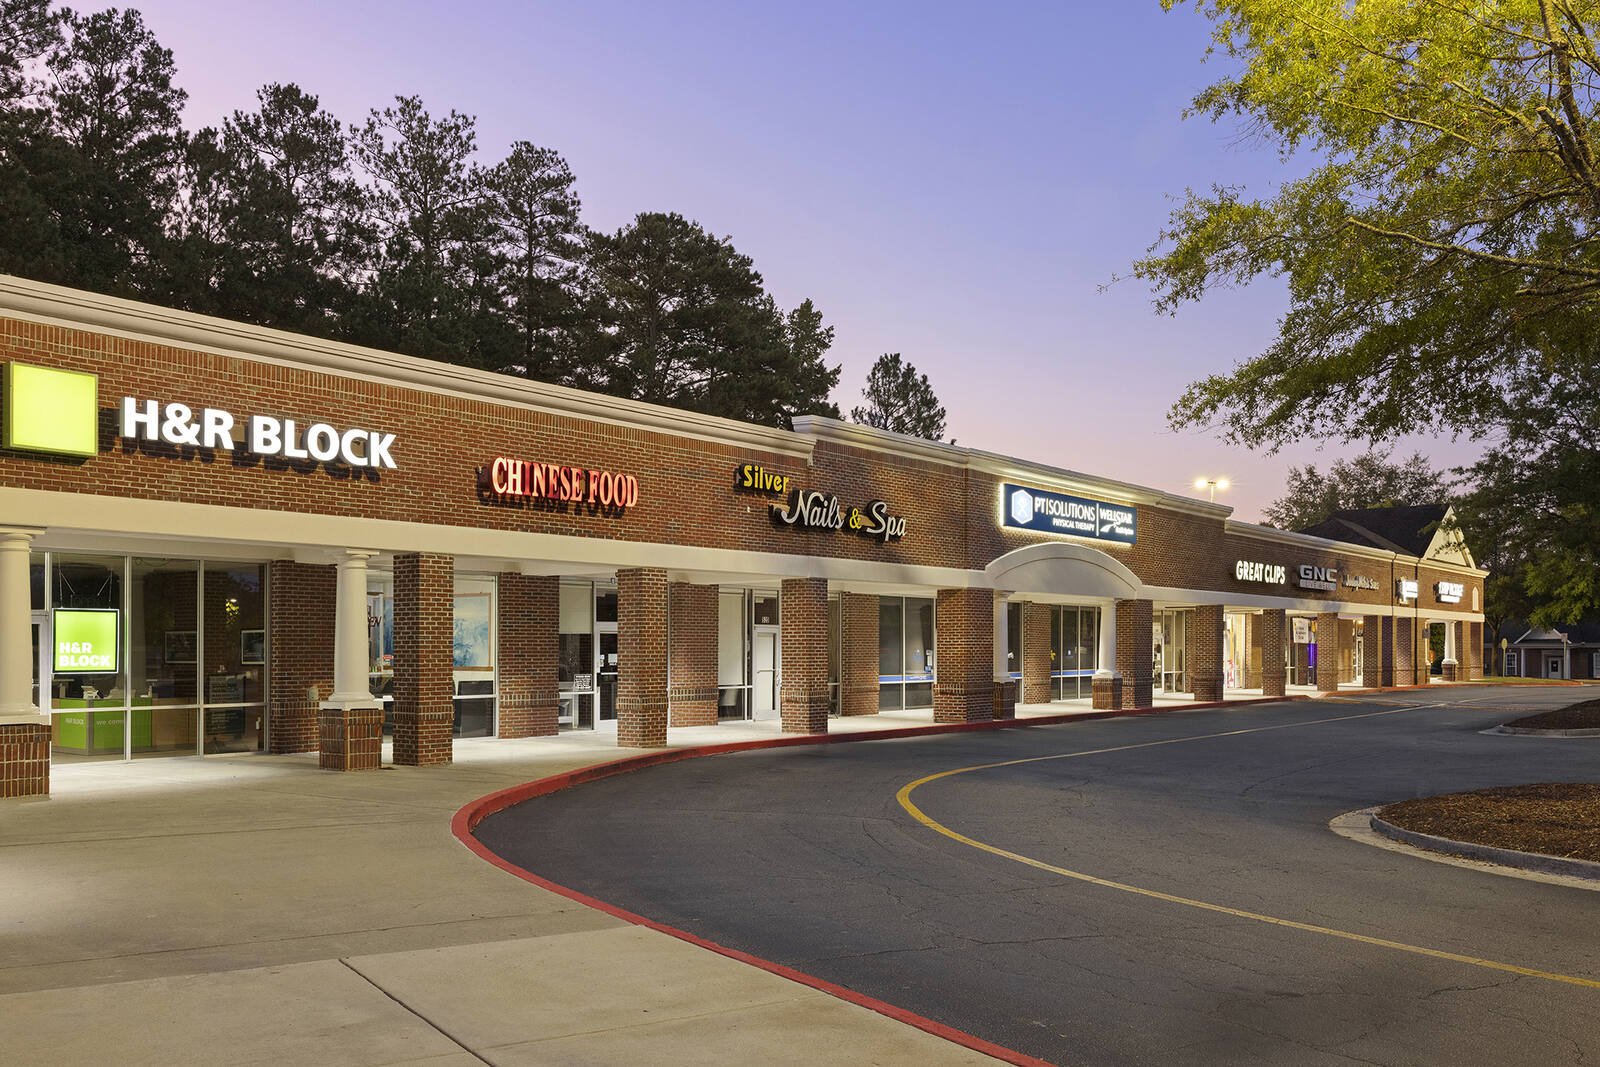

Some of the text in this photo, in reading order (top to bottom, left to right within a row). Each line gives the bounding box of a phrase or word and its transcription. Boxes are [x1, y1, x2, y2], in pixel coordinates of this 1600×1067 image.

[121, 396, 398, 470] H&R BLOCK
[490, 456, 639, 508] CHINESE FOOD
[743, 464, 790, 493] Silver
[781, 490, 907, 542] Nails & Spa
[1034, 496, 1095, 521] PT SOLUTIONS
[1052, 517, 1095, 532] PHYSICAL THERAPY
[1236, 560, 1286, 585] GREAT CLIPS
[1299, 564, 1337, 582] GNC
[58, 654, 111, 667] BLOCK
[59, 642, 92, 654] H&R
